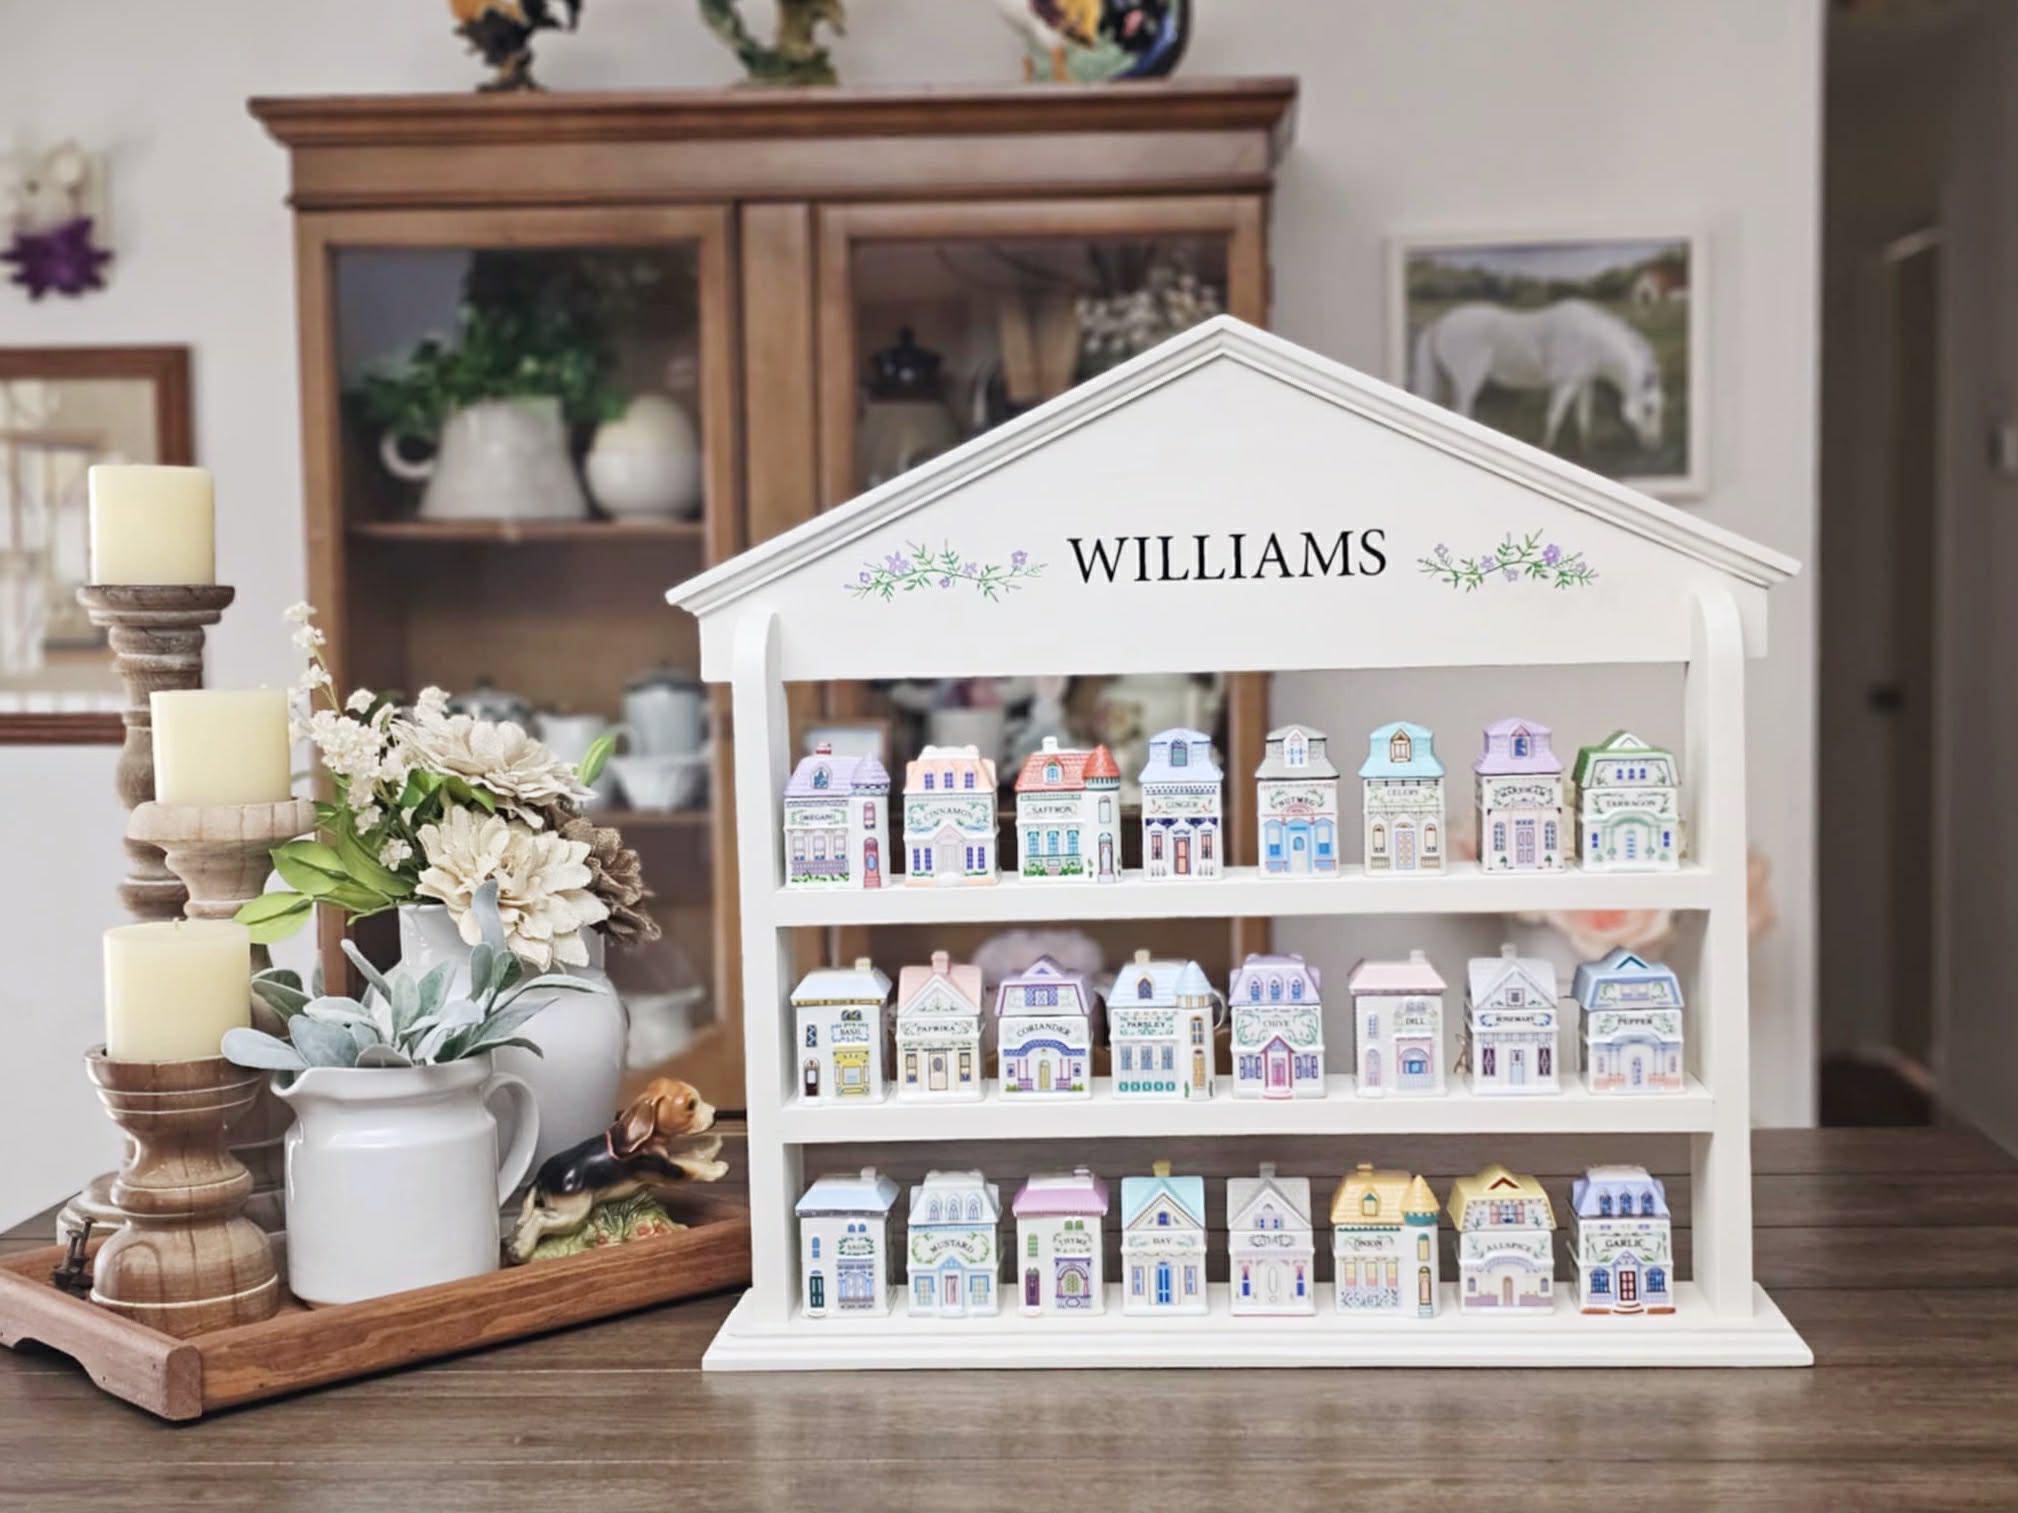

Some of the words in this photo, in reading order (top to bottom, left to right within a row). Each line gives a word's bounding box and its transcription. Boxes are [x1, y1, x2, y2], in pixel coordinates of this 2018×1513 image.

[1067, 529, 1387, 583] WILLIAMS
[1278, 796, 1316, 808] NUTMEG
[923, 807, 974, 821] CINNAMON
[1031, 805, 1073, 815] SAFFRON
[1126, 1020, 1167, 1029] PARSLEY
[1617, 1017, 1653, 1026] PEPPER
[916, 1025, 956, 1033] PAPRIKA
[1016, 1023, 1073, 1038] CORIANDER
[929, 1238, 974, 1253] MUSTARD
[1486, 1241, 1533, 1252] ALLSPICE
[1605, 1239, 1645, 1248] GARLIC
